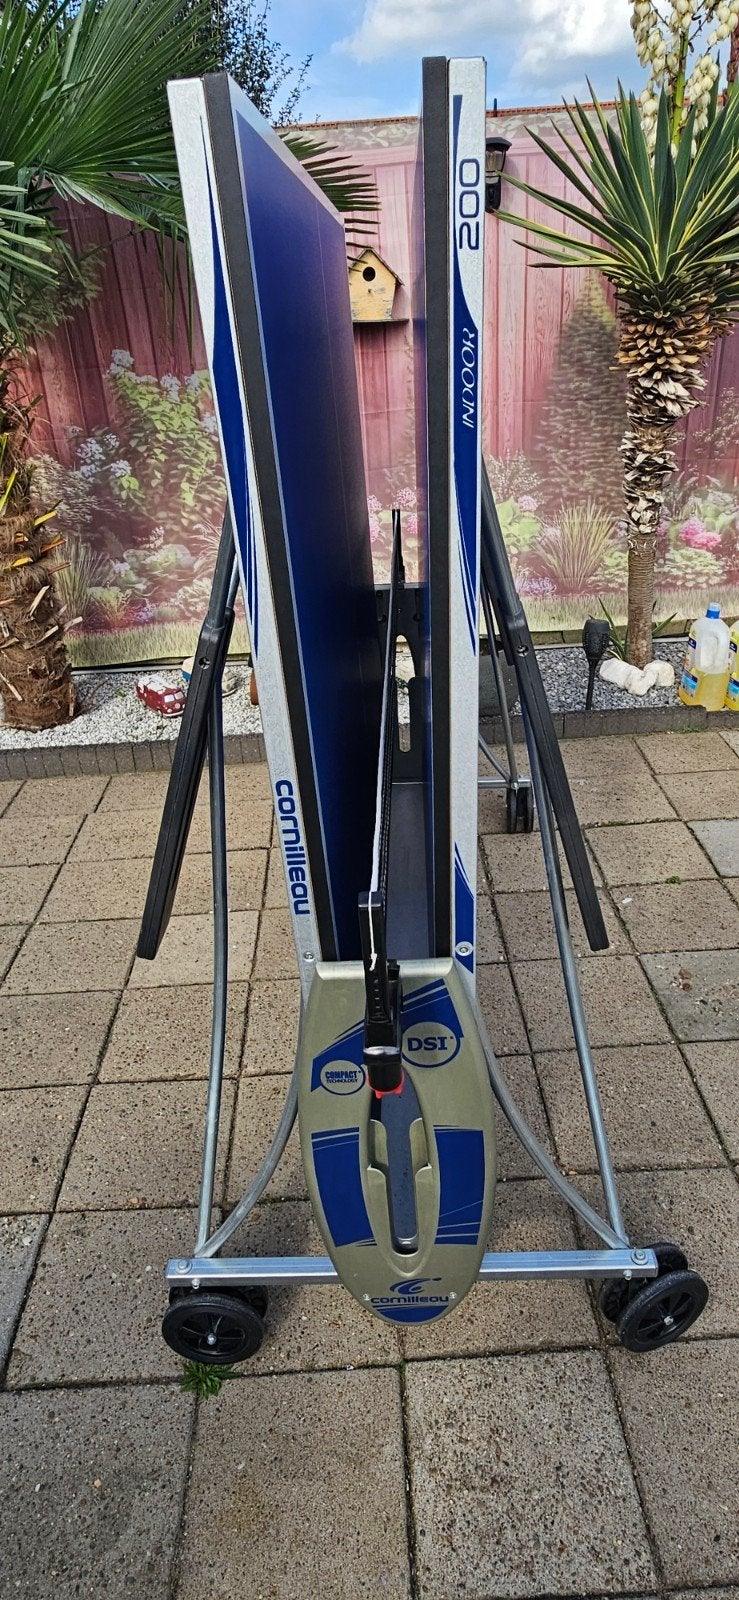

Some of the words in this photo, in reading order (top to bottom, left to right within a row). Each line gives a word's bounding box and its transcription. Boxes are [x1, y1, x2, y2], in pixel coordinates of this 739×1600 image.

[459, 158, 480, 250] 200
[462, 327, 476, 429] INDOOR
[275, 779, 310, 915] cornilleau
[407, 1036, 448, 1052] DSI
[325, 1070, 359, 1079] COMPACT
[370, 1295, 449, 1304] cornilleau
